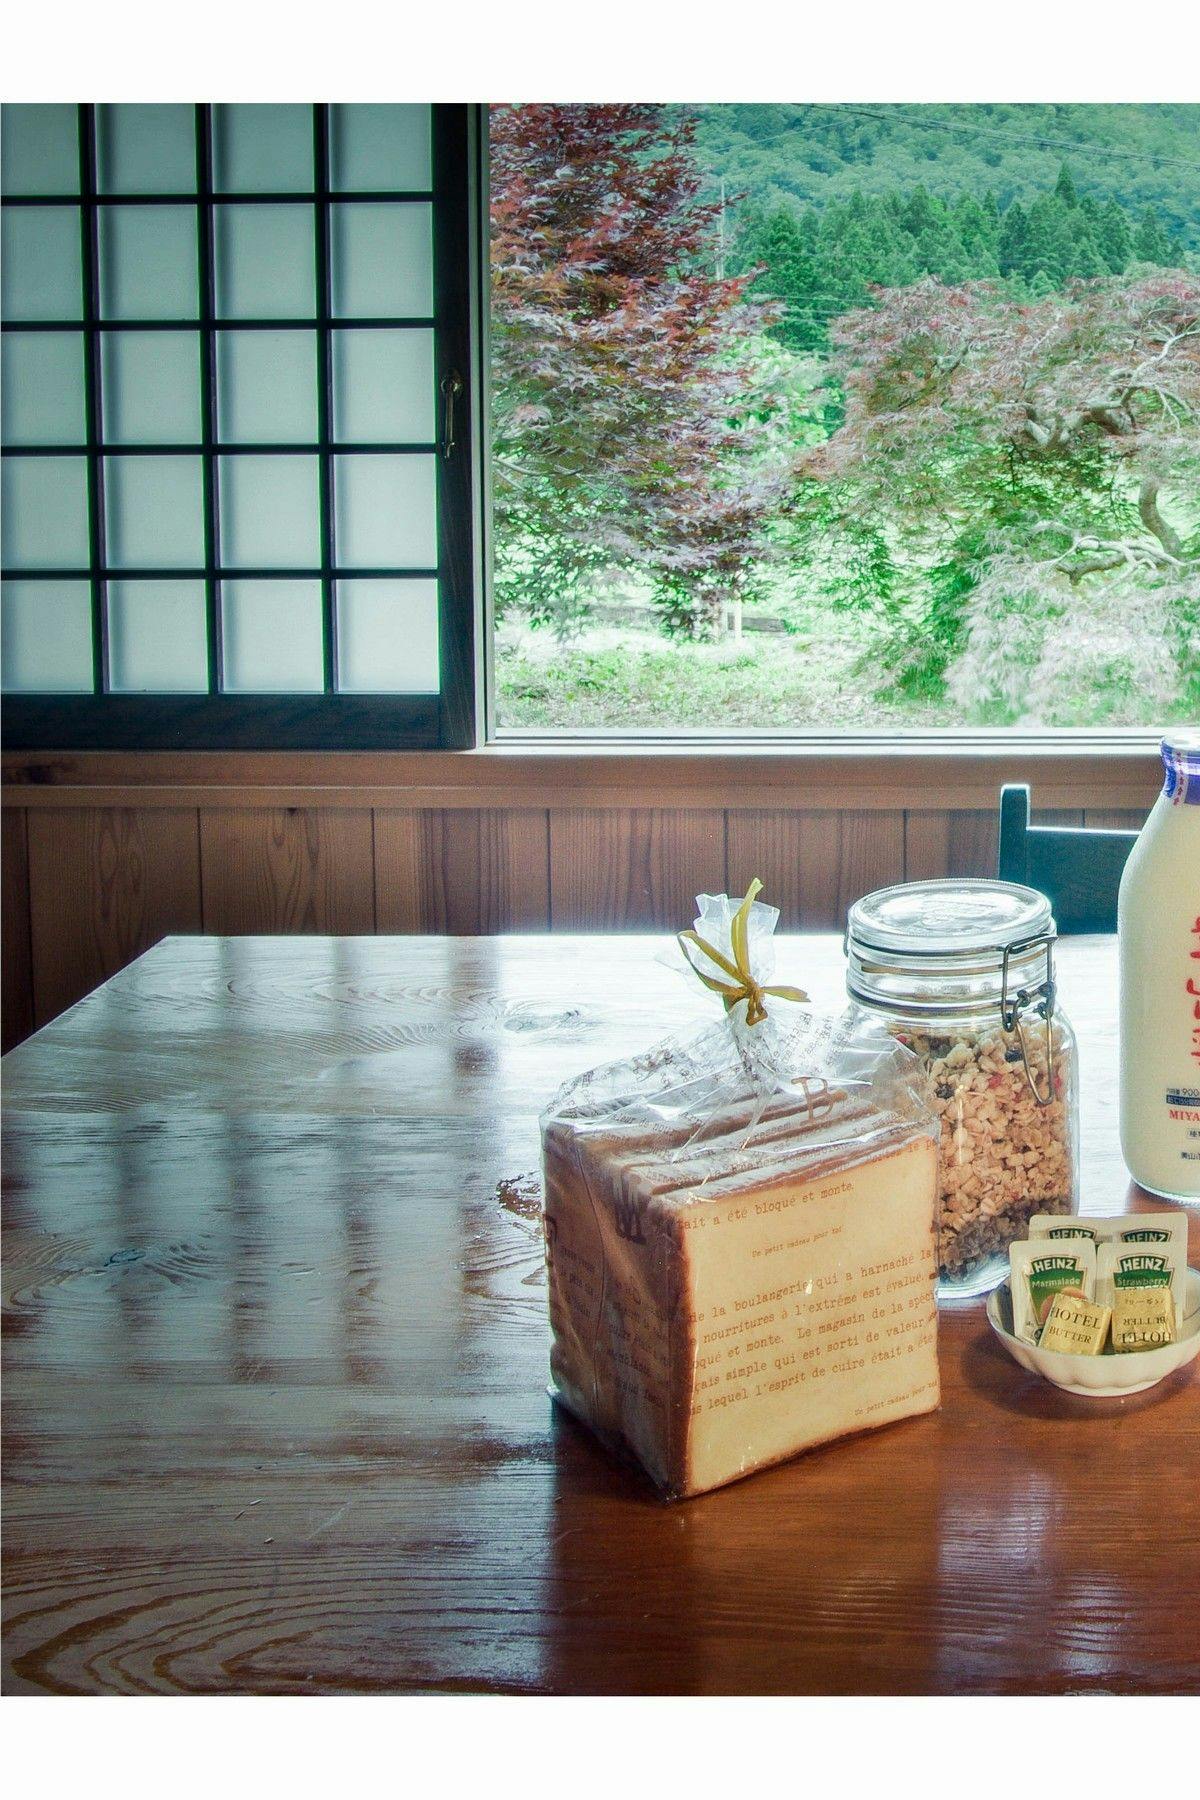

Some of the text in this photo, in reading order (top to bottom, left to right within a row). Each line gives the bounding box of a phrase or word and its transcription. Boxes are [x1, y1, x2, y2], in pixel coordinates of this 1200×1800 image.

[802, 1191, 814, 1203] et
[1033, 1258, 1076, 1272] HEINZ
[1122, 1258, 1163, 1272] HEINZ
[1032, 1277, 1080, 1287] Marmalade
[1117, 1277, 1168, 1287] Strawberry
[711, 1306, 727, 1318] la
[734, 1279, 809, 1312] boulangerie
[816, 1273, 838, 1290] qui
[703, 1312, 775, 1344] nourritures
[862, 1286, 881, 1299] est
[1050, 1307, 1101, 1330] HOTEL
[727, 1345, 741, 1358] et
[797, 1326, 812, 1339] Le
[818, 1311, 865, 1335] magasin
[872, 1307, 885, 1320] de
[890, 1302, 904, 1314] la
[1048, 1326, 1092, 1344] BUTTER
[726, 1361, 767, 1381] simple
[774, 1353, 796, 1370] qui
[803, 1346, 821, 1360] est
[827, 1335, 860, 1352] sorti
[866, 1331, 880, 1343] de
[886, 1319, 924, 1337] valeur
[708, 1388, 748, 1410] lequel
[755, 1372, 806, 1396] l'esprit
[812, 1366, 826, 1378] de
[831, 1358, 865, 1373] cuire
